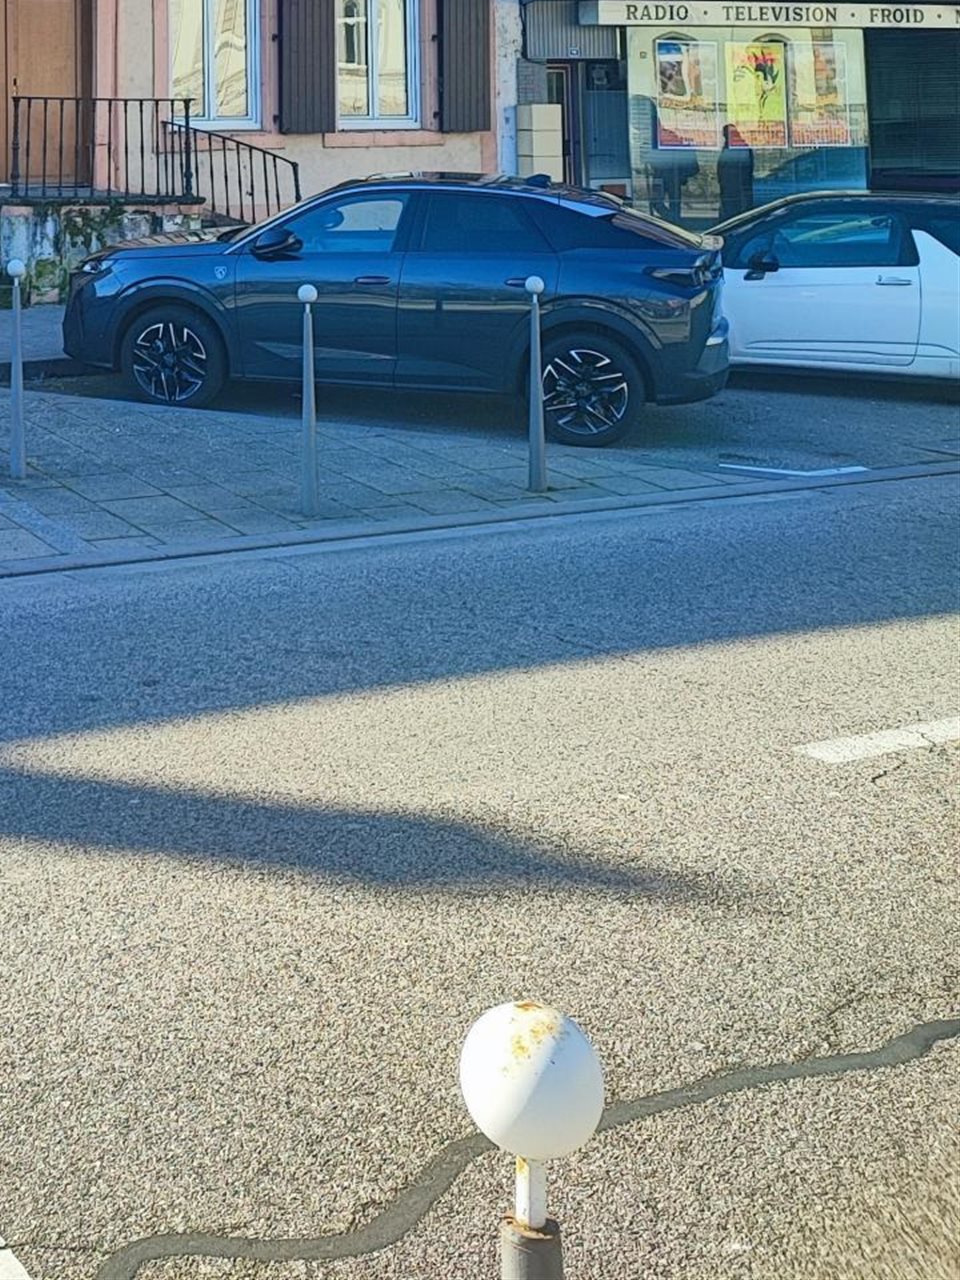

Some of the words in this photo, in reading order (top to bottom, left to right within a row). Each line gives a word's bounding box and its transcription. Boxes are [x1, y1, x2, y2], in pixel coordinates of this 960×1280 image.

[626, 4, 689, 21] RADIO
[722, 6, 838, 22] TELEVISION
[869, 7, 925, 23] FROID
